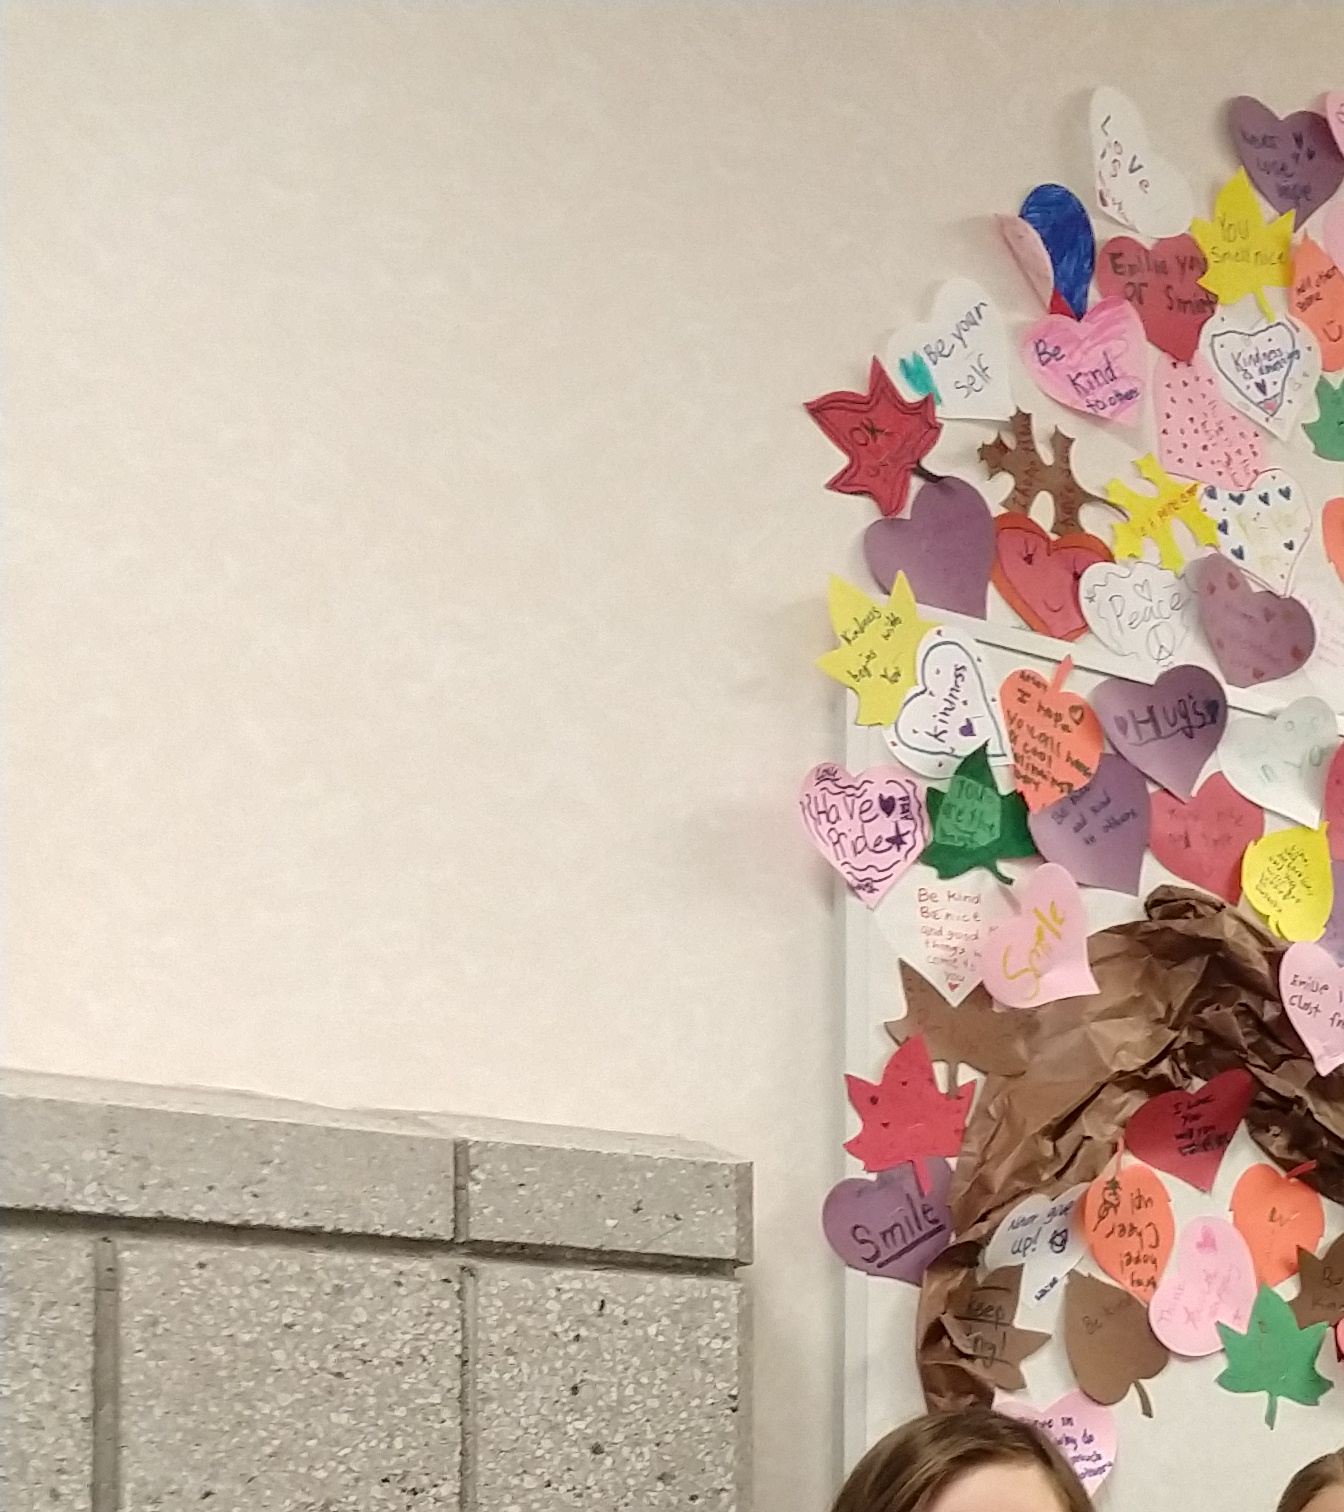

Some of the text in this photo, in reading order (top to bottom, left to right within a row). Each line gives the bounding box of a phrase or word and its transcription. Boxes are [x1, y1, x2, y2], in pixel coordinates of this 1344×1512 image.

[1033, 338, 1066, 367] Be
[1108, 591, 1185, 635] Peace
[918, 887, 939, 903] Be
[851, 1193, 941, 1263] Smile
